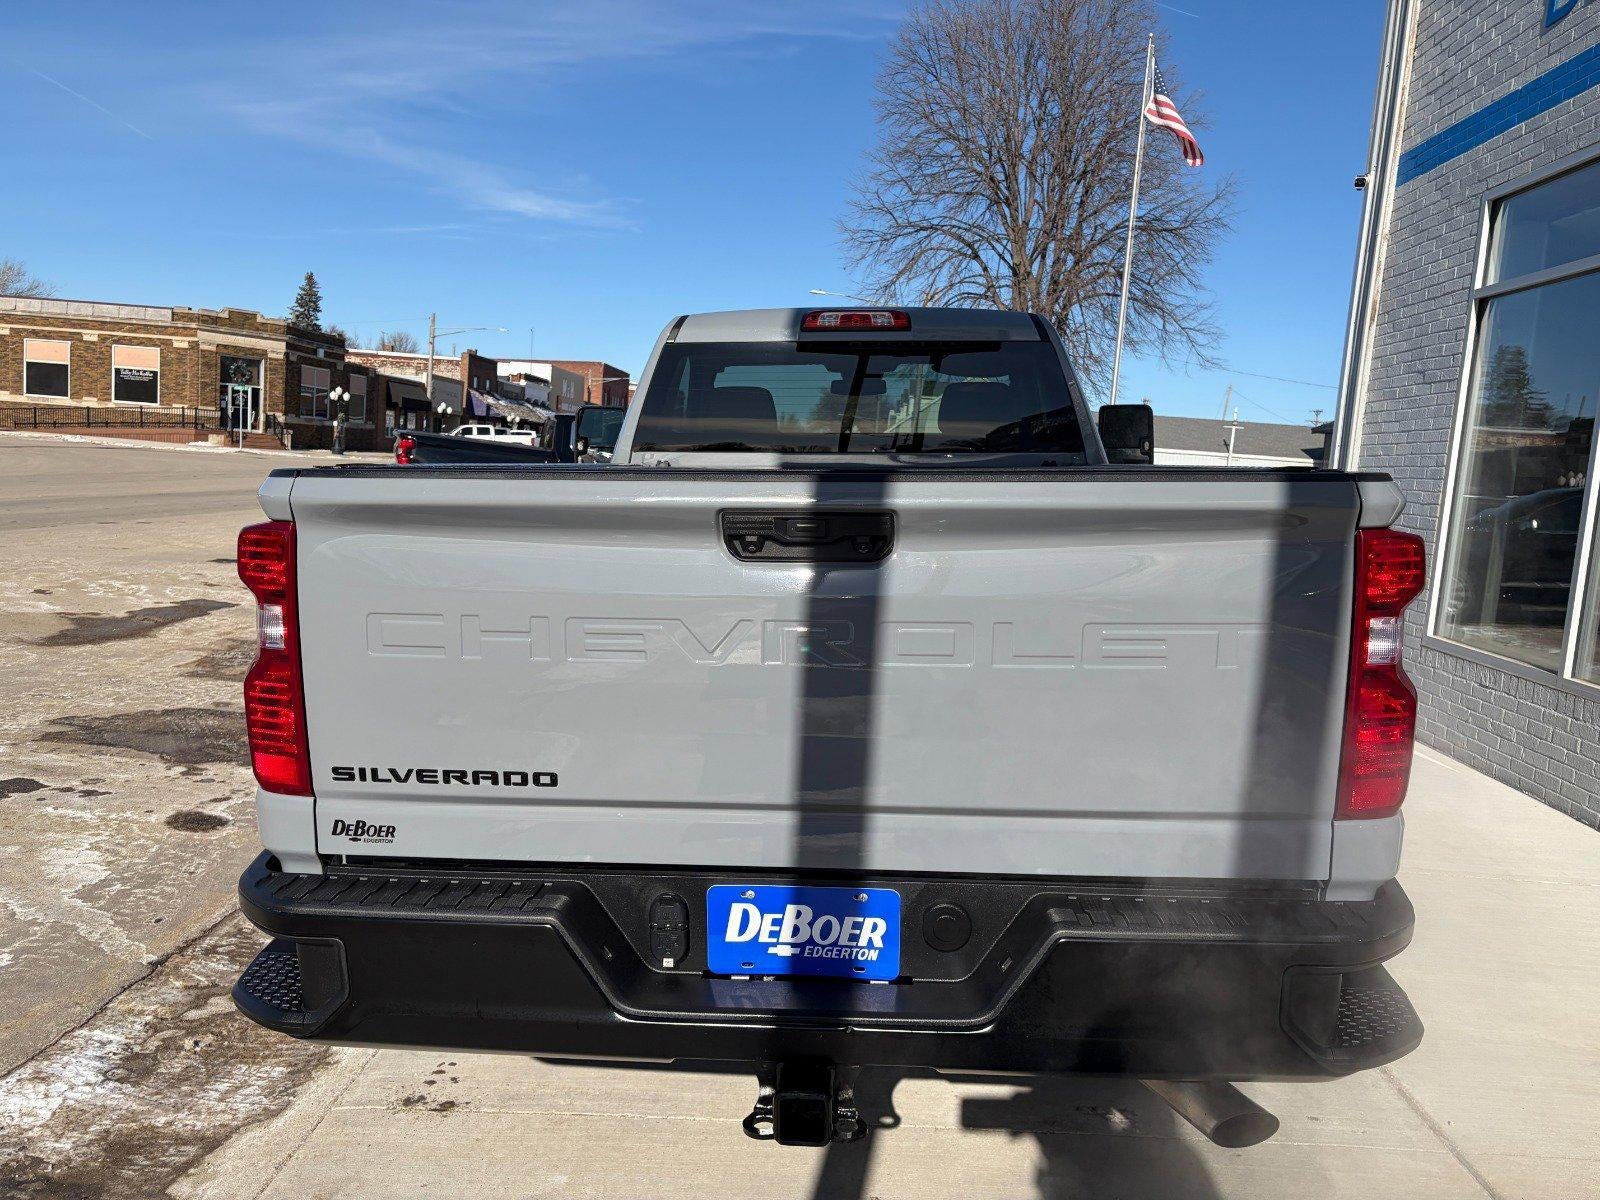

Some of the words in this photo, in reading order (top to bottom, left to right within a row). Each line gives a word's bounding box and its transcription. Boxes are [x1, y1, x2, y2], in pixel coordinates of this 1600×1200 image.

[366, 612, 1274, 671] CHEVROLET
[331, 766, 559, 788] SILVERADO
[804, 946, 879, 961] EDGERTON
